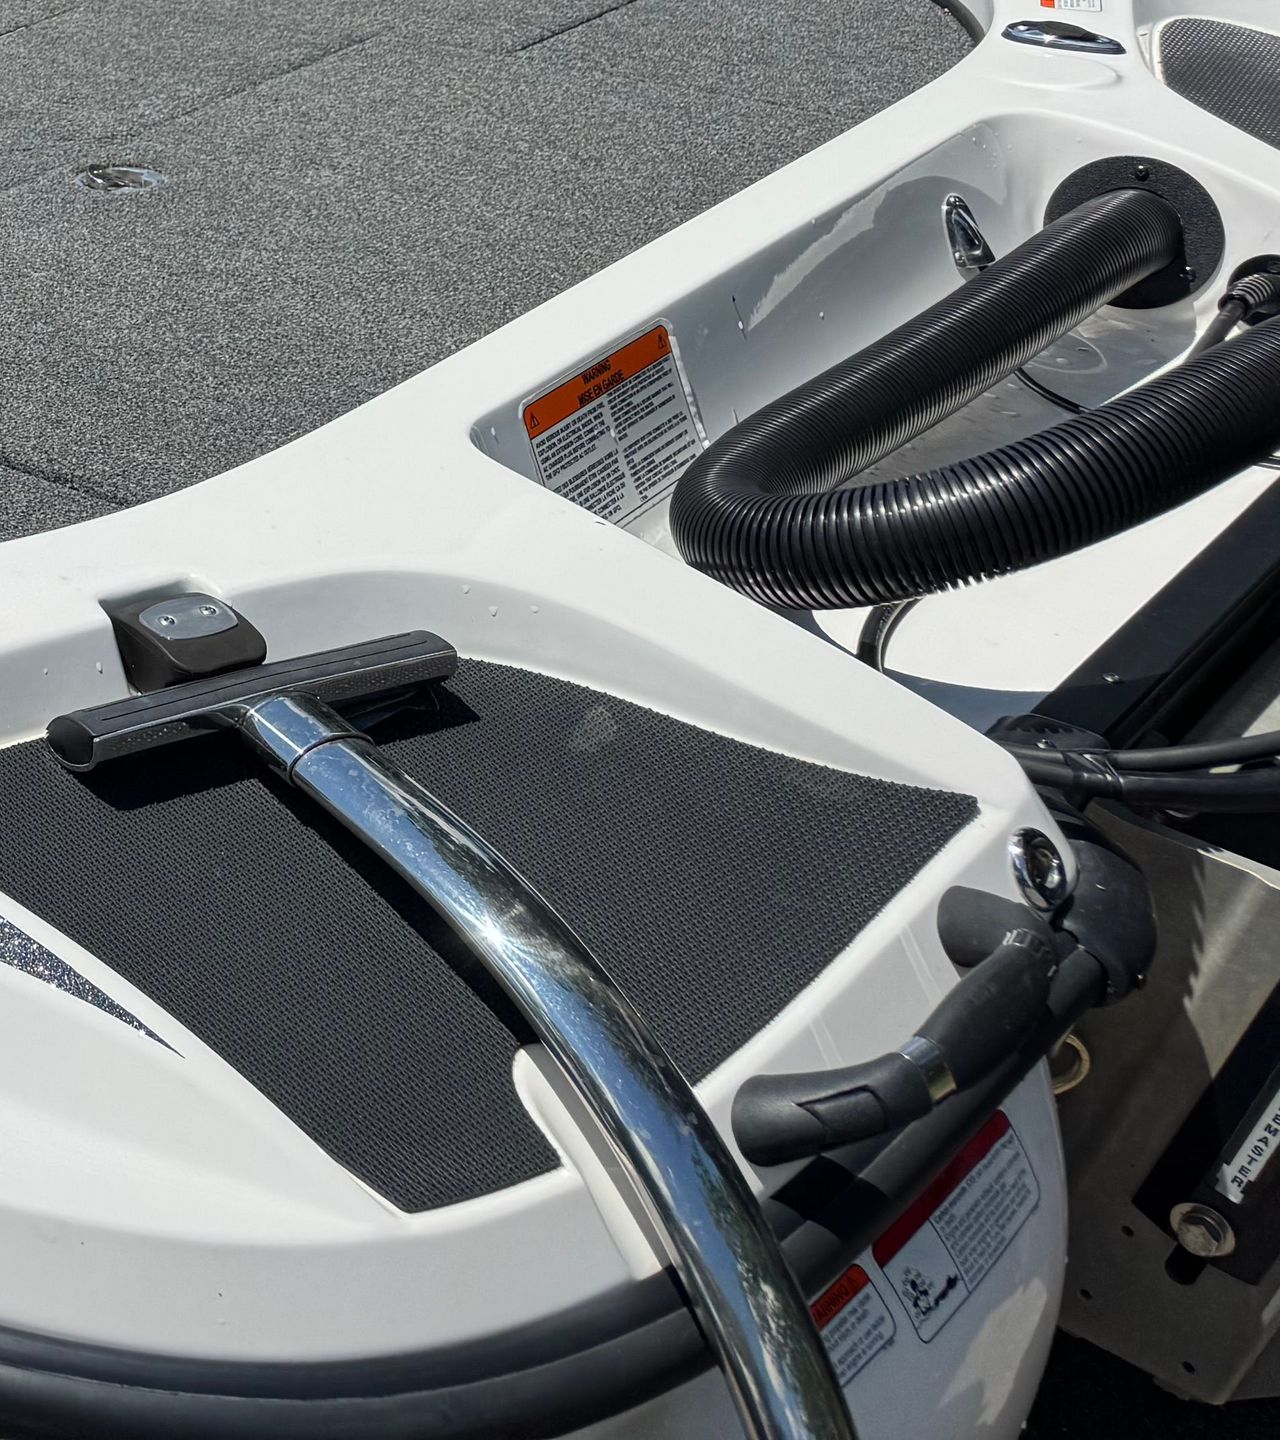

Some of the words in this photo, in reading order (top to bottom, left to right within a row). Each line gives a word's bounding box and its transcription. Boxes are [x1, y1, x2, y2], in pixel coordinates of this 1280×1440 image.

[578, 388, 595, 406] MISE
[592, 382, 603, 396] EN
[602, 369, 625, 391] GARDE
[582, 359, 612, 385] WARNING
[1230, 1107, 1280, 1188] EMASTER
[815, 1283, 850, 1324] ARNING
